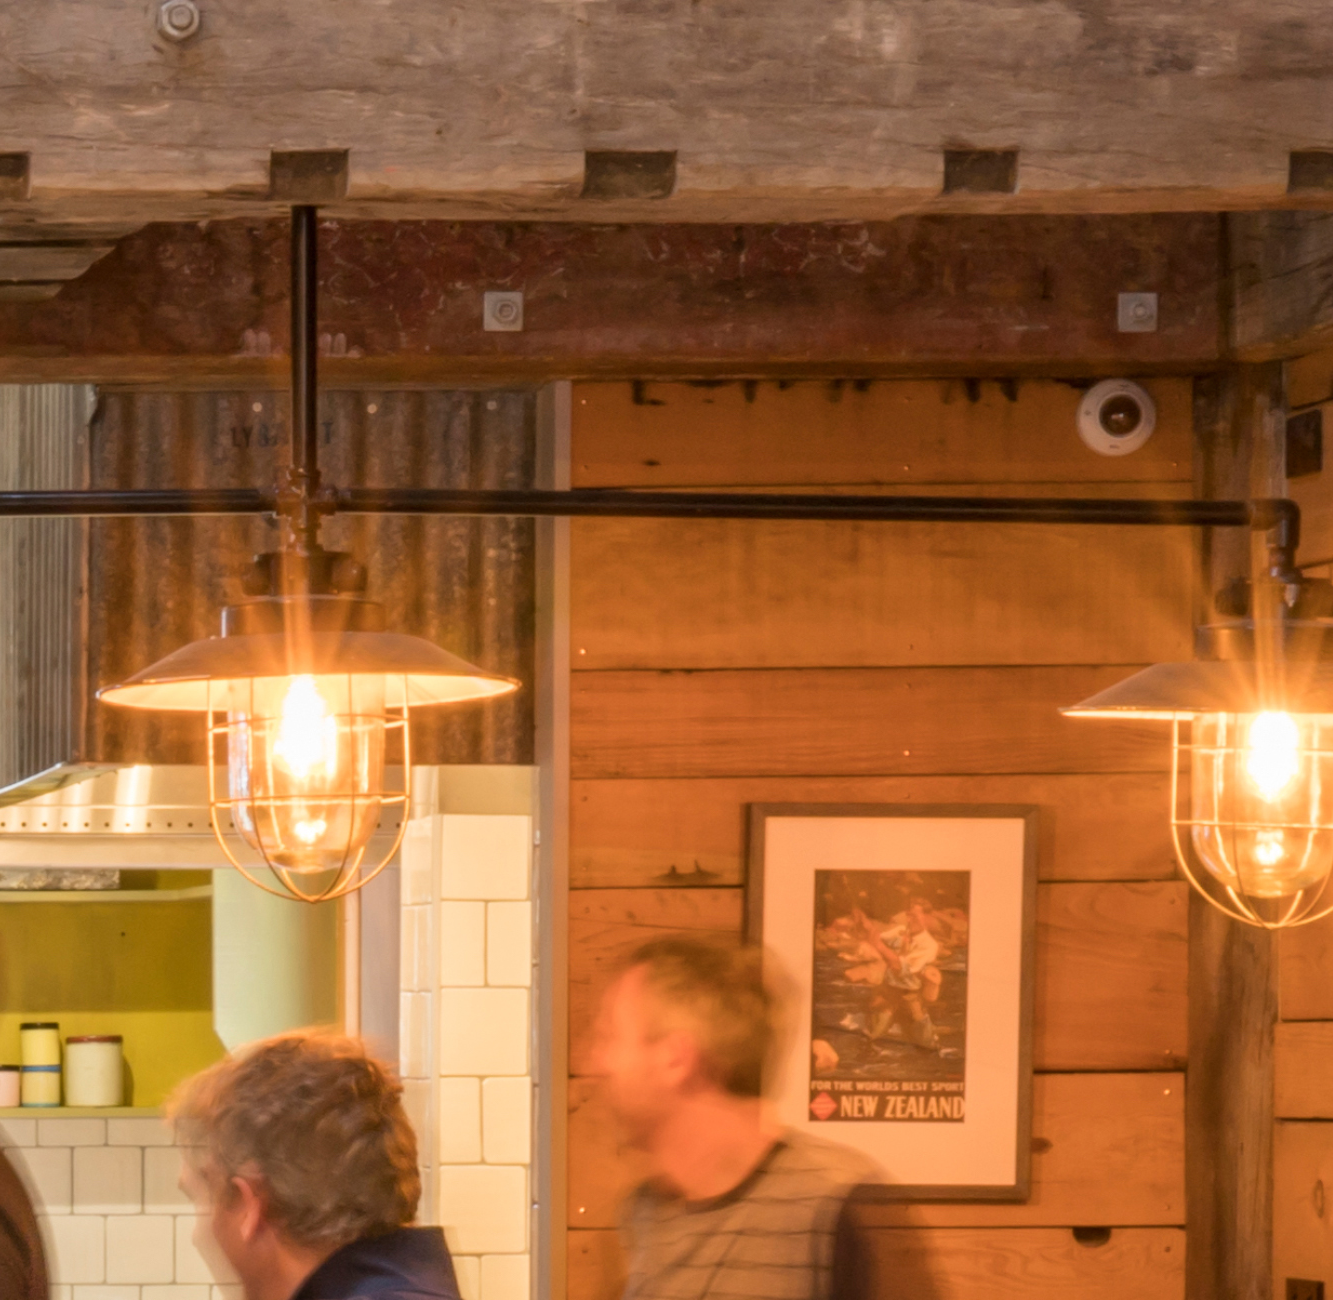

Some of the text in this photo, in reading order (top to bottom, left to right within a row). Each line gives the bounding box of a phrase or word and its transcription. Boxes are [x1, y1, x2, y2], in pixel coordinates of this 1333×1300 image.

[810, 1080, 831, 1091] FOR
[833, 1080, 853, 1091] THE
[901, 1081, 928, 1092] BEST
[931, 1081, 964, 1092] SPORT
[840, 1095, 879, 1117] NEW
[884, 1095, 965, 1119] ZEALAND
